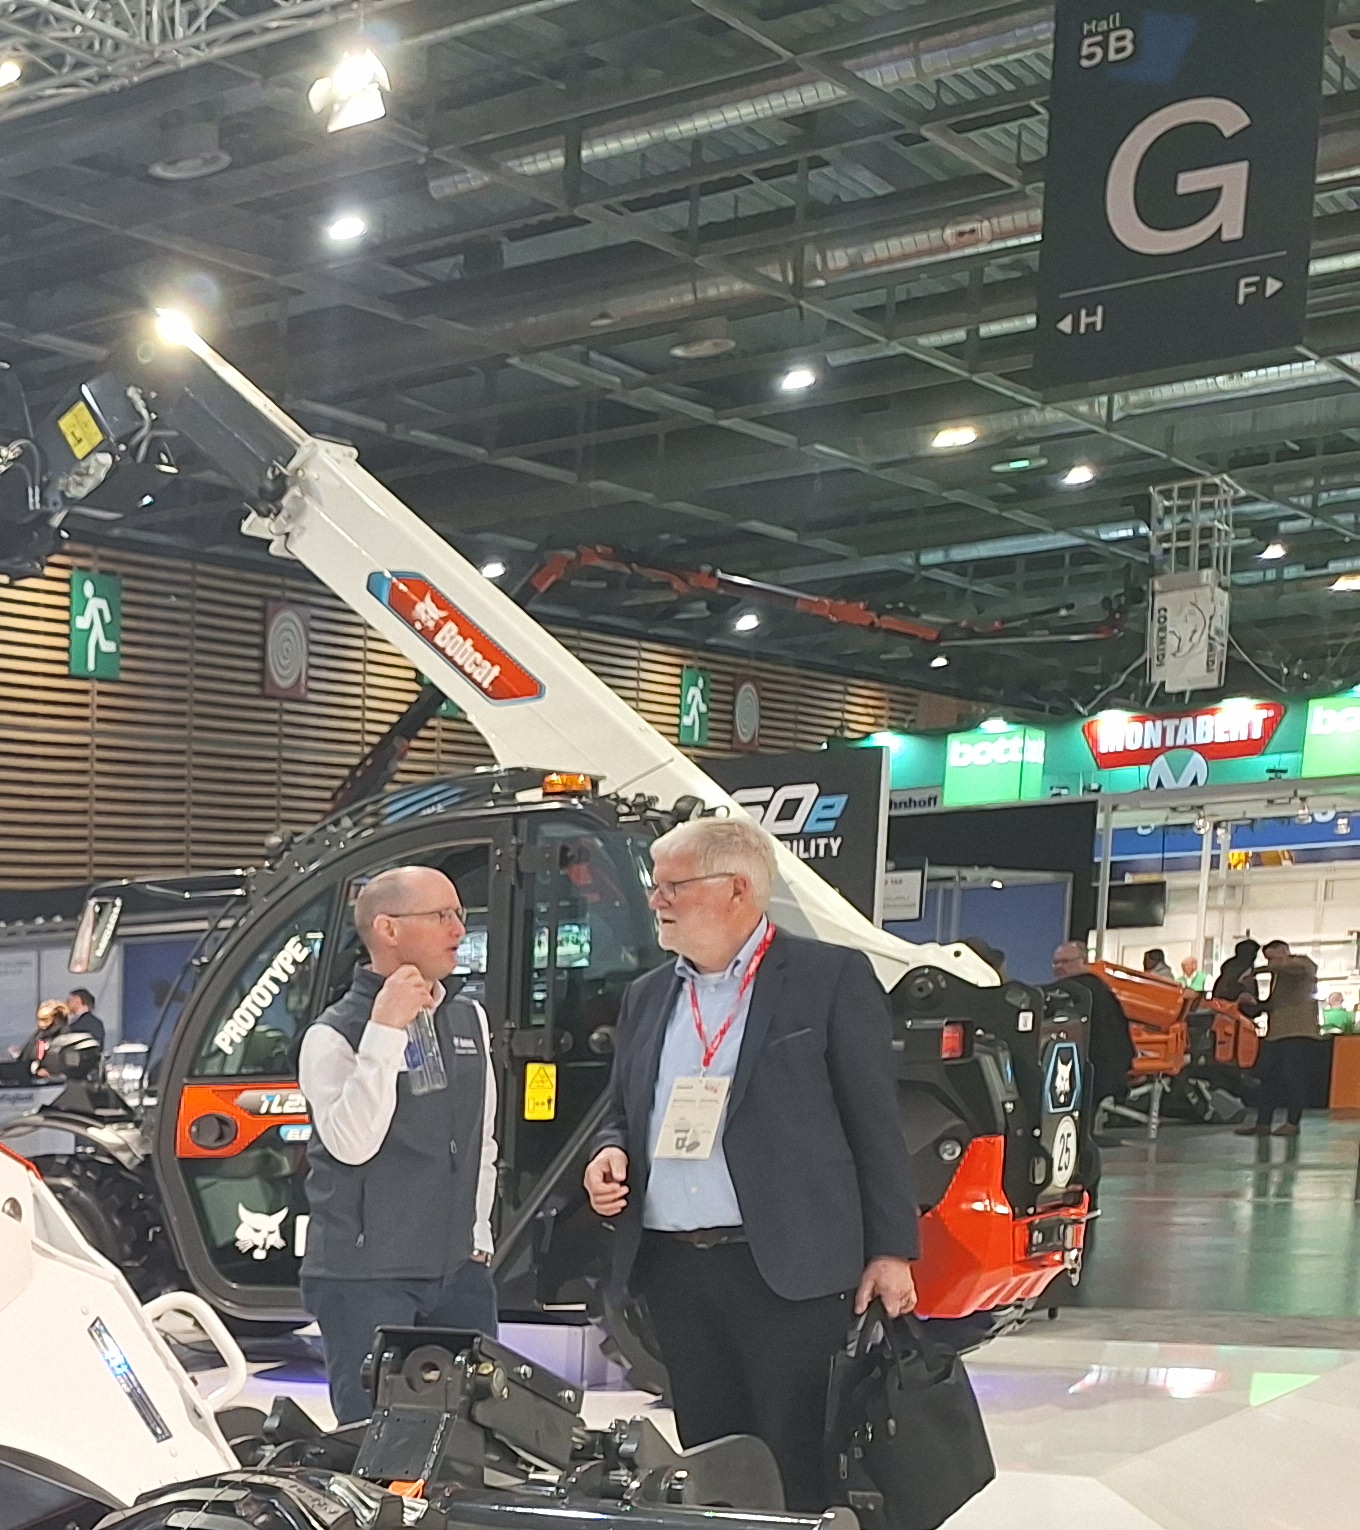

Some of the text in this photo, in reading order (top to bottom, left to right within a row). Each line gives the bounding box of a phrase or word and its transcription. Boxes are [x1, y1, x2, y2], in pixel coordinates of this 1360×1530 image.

[1082, 12, 1120, 34] Hall
[1079, 28, 1135, 69] 5B
[1106, 96, 1252, 256] G
[1237, 276, 1261, 305] F
[1079, 305, 1104, 334] H
[433, 620, 502, 689] Bobcat
[1097, 708, 1269, 754] MONTABERT
[213, 934, 313, 1056] PROTOTYPE
[1057, 1132, 1072, 1173] 25
